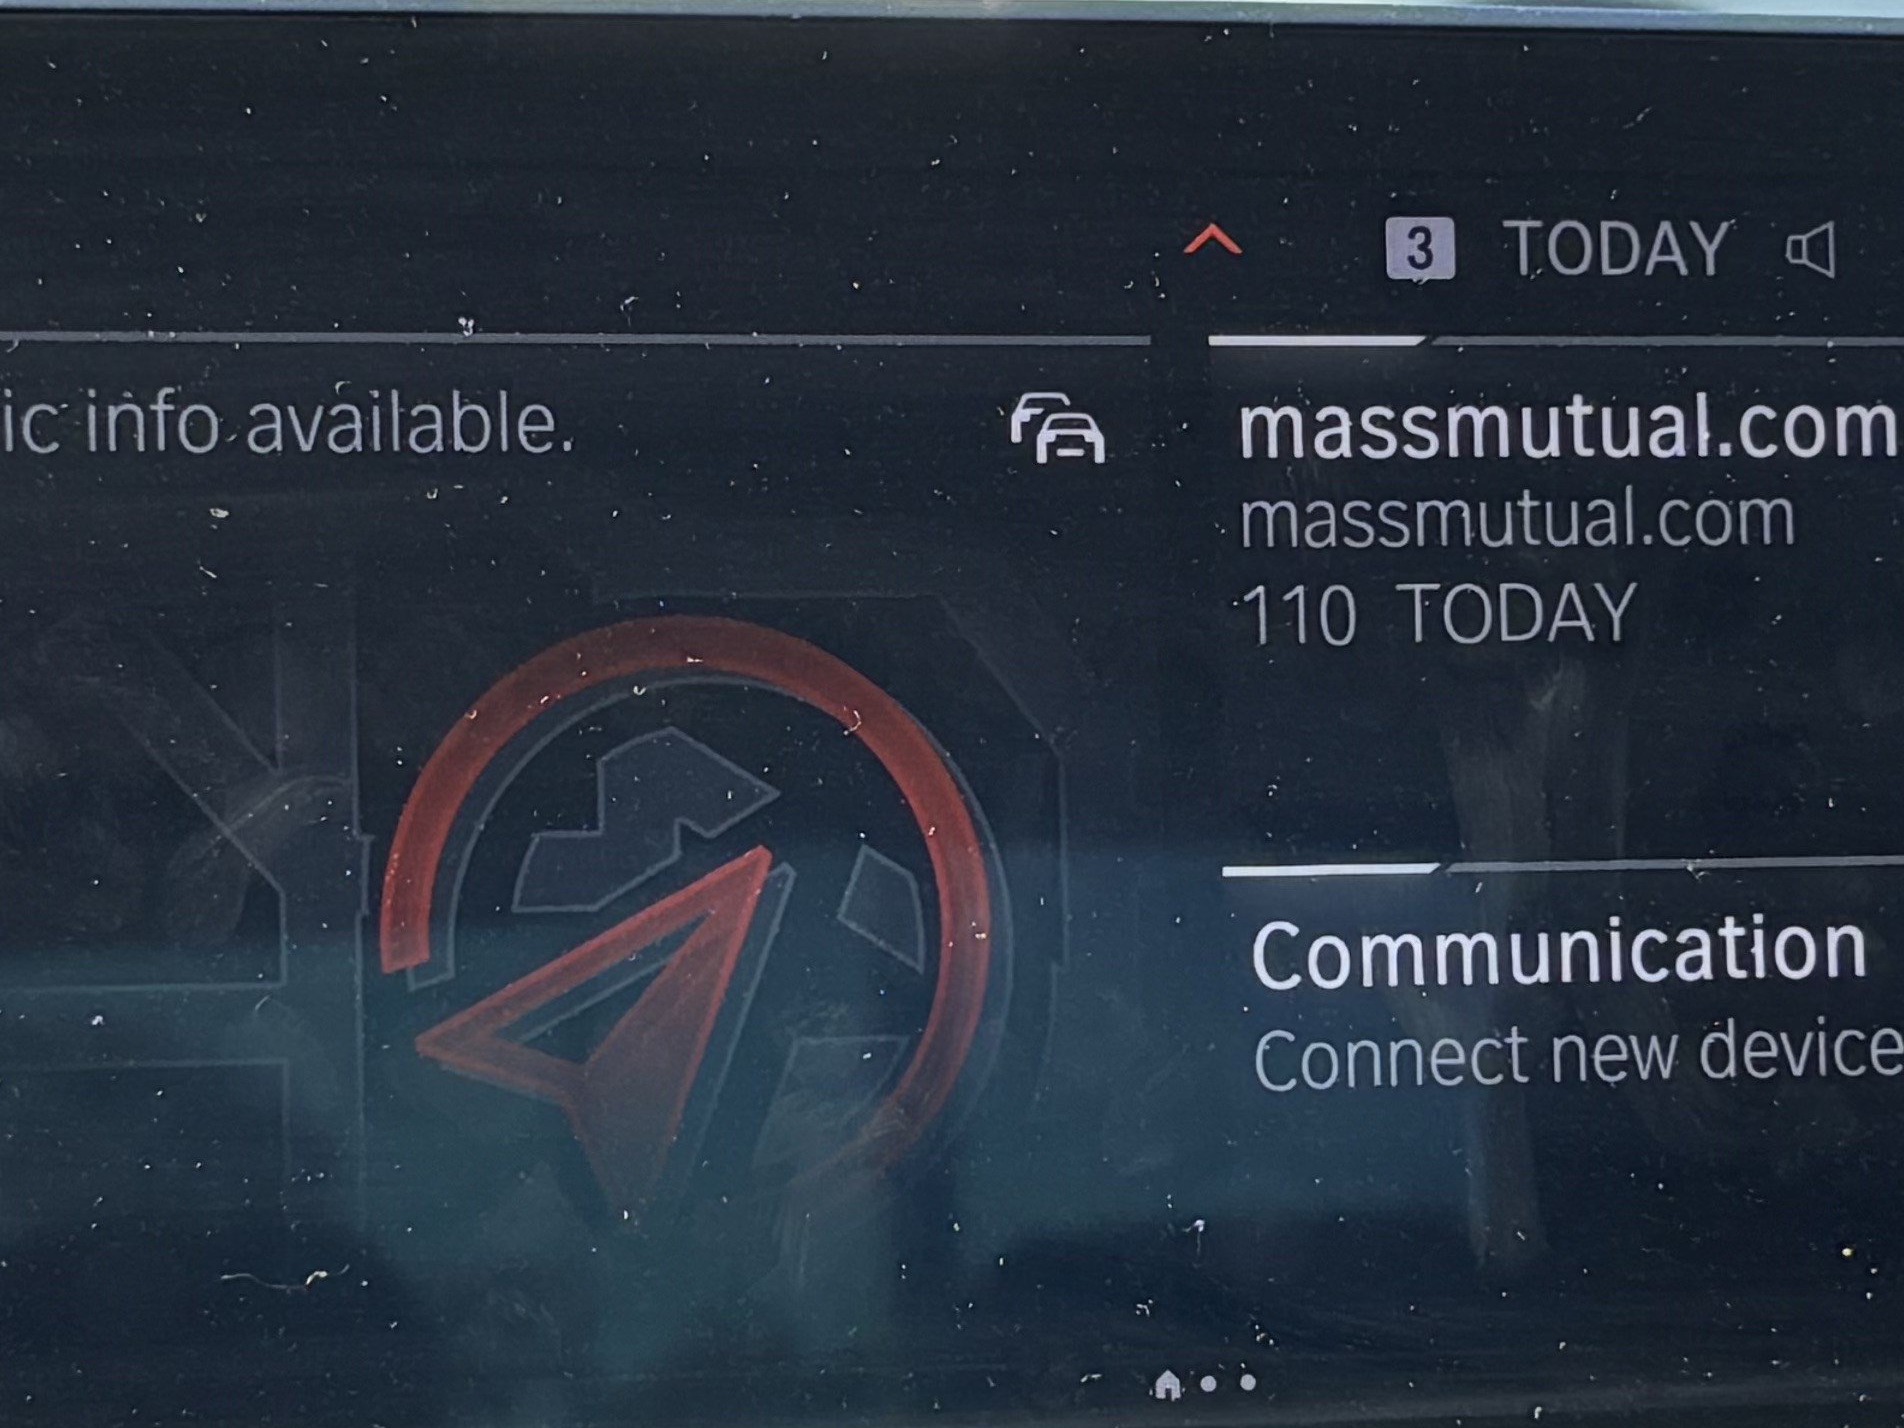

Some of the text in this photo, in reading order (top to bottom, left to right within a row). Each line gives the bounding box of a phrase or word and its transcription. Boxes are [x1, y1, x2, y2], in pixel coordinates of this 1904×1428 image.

[1406, 226, 1435, 271] 3
[1503, 220, 1731, 277] TODAY
[87, 387, 220, 455] info
[247, 389, 574, 454] available.
[1240, 391, 1899, 460] massmutual.com
[1241, 485, 1795, 549] massmutual.com
[1243, 582, 1638, 647] 110 TODAY
[1252, 913, 1867, 991] Communication
[1255, 1026, 1529, 1093] Connect
[1552, 1032, 1680, 1083] new
